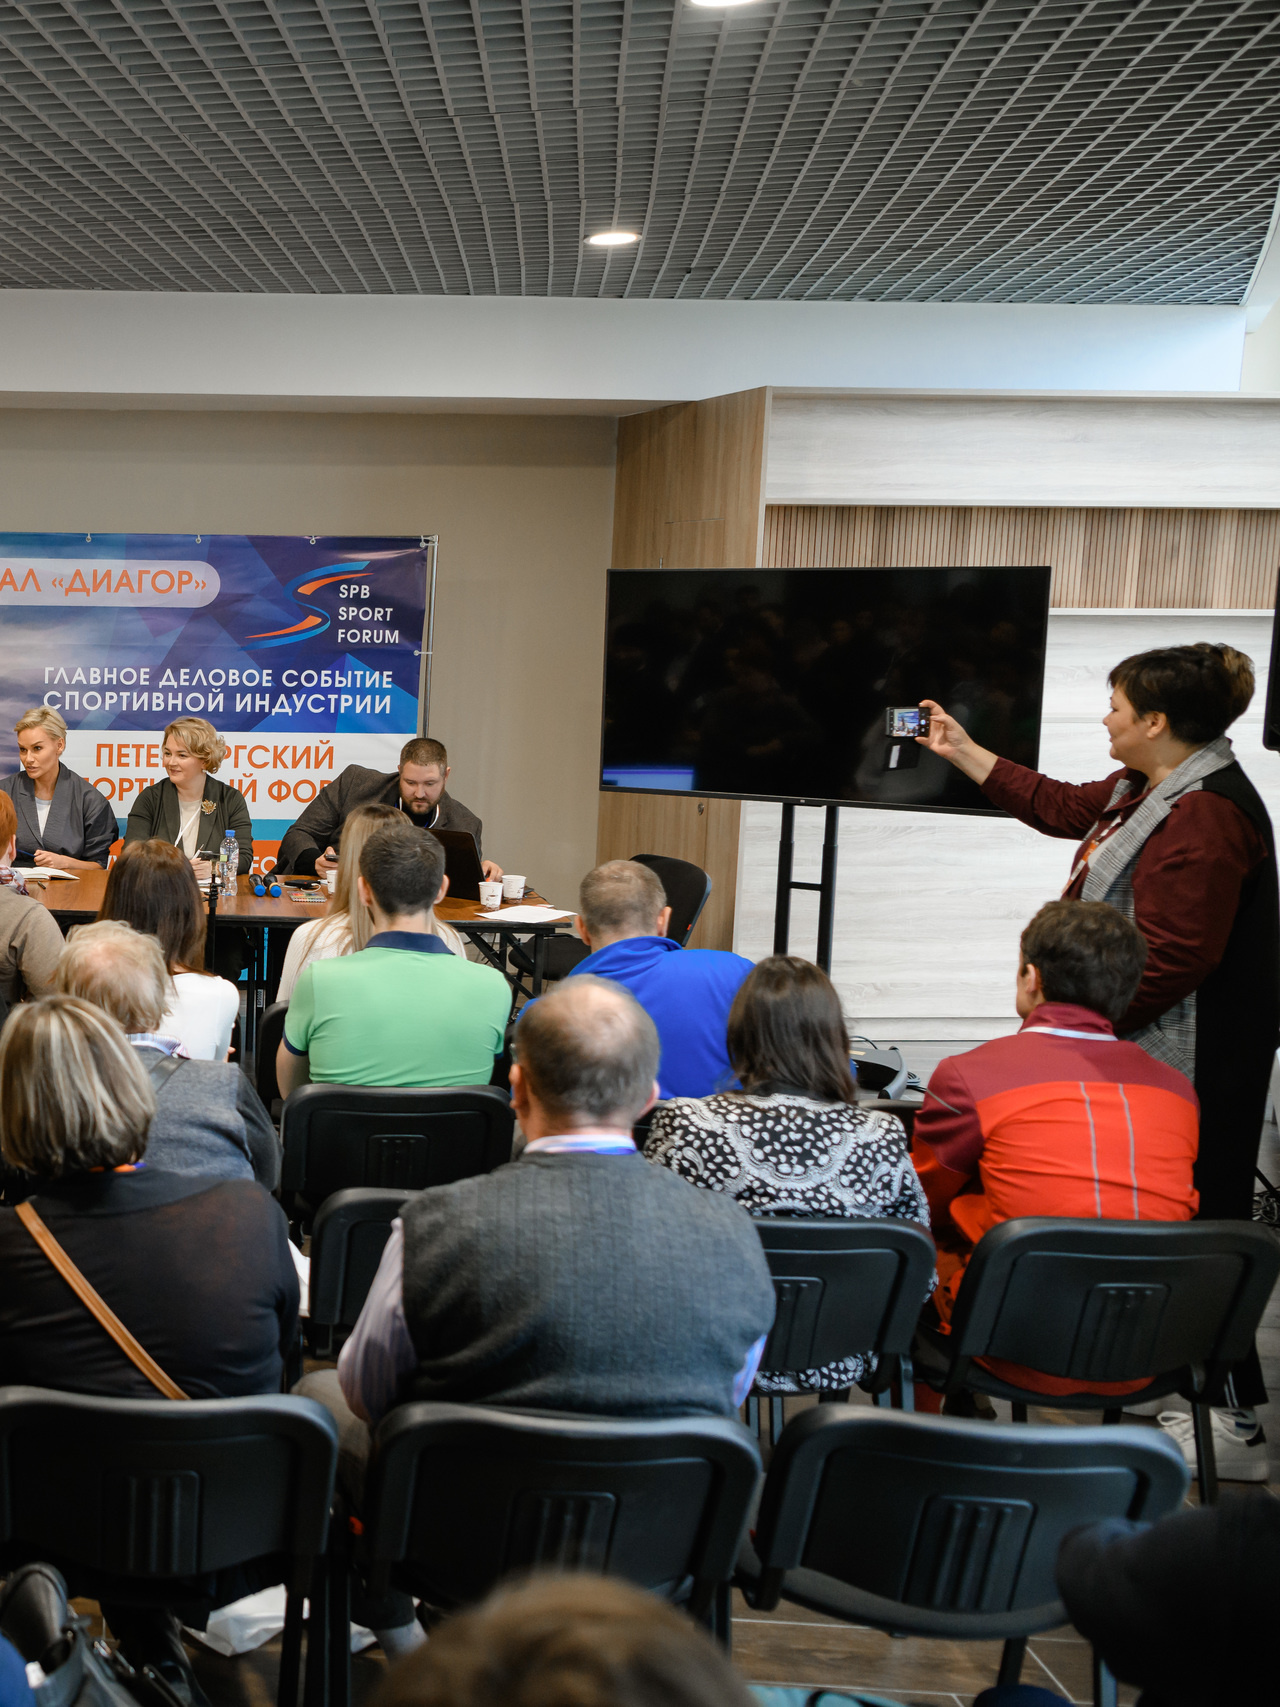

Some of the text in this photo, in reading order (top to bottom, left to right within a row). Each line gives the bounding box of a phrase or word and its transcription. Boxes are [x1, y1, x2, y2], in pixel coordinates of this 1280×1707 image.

[52, 568, 207, 597] «ДИАГОР»
[339, 584, 370, 598] SPB
[338, 606, 393, 621] SPORT
[337, 629, 399, 644] FORUM
[44, 666, 393, 688] ГЛАВНОЕ ДЕЛОВОЕ СОБЫТИЕ
[43, 688, 391, 716] СПОРТИВНОЙ ИНДУСТРИИ
